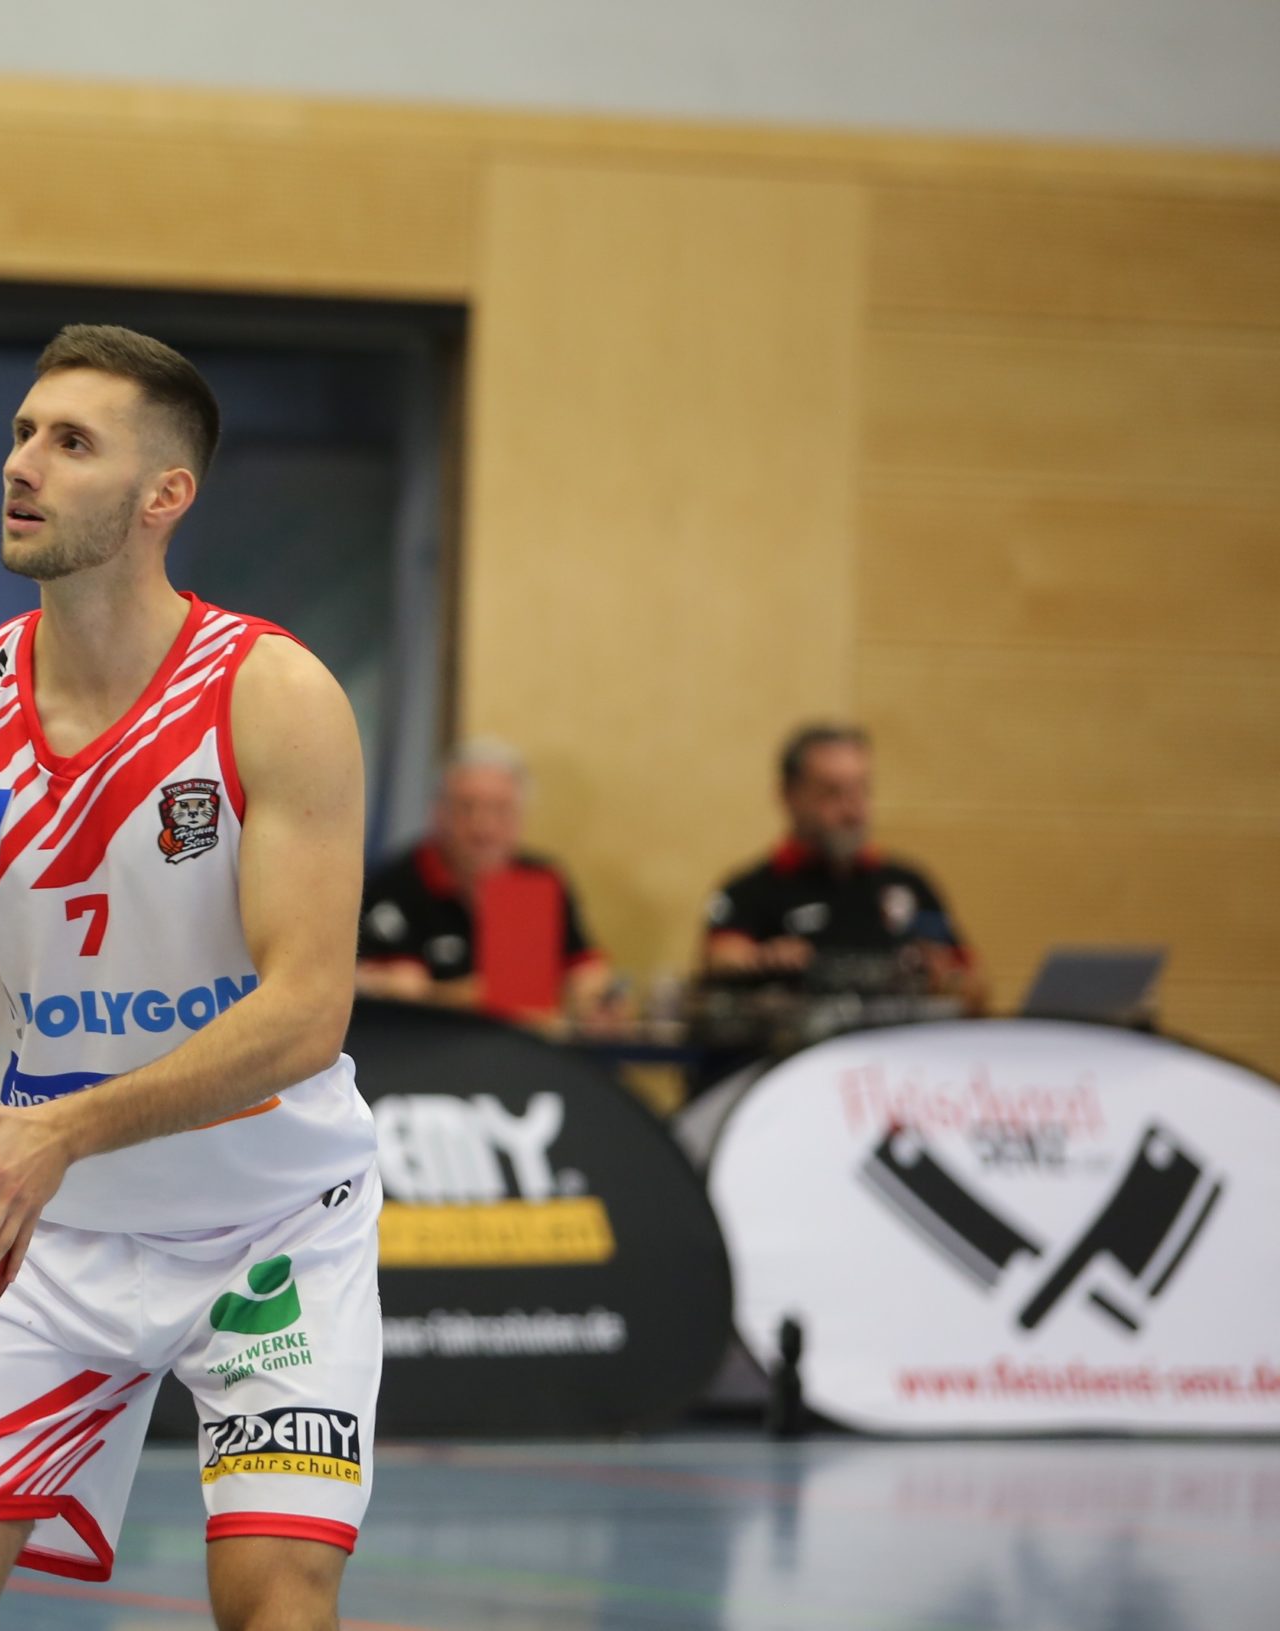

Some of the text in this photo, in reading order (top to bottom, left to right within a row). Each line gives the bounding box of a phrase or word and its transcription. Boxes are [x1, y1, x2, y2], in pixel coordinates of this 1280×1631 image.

[65, 894, 108, 957] 7
[261, 1350, 312, 1372] GmbH
[232, 1455, 360, 1482] Fahrschulen
